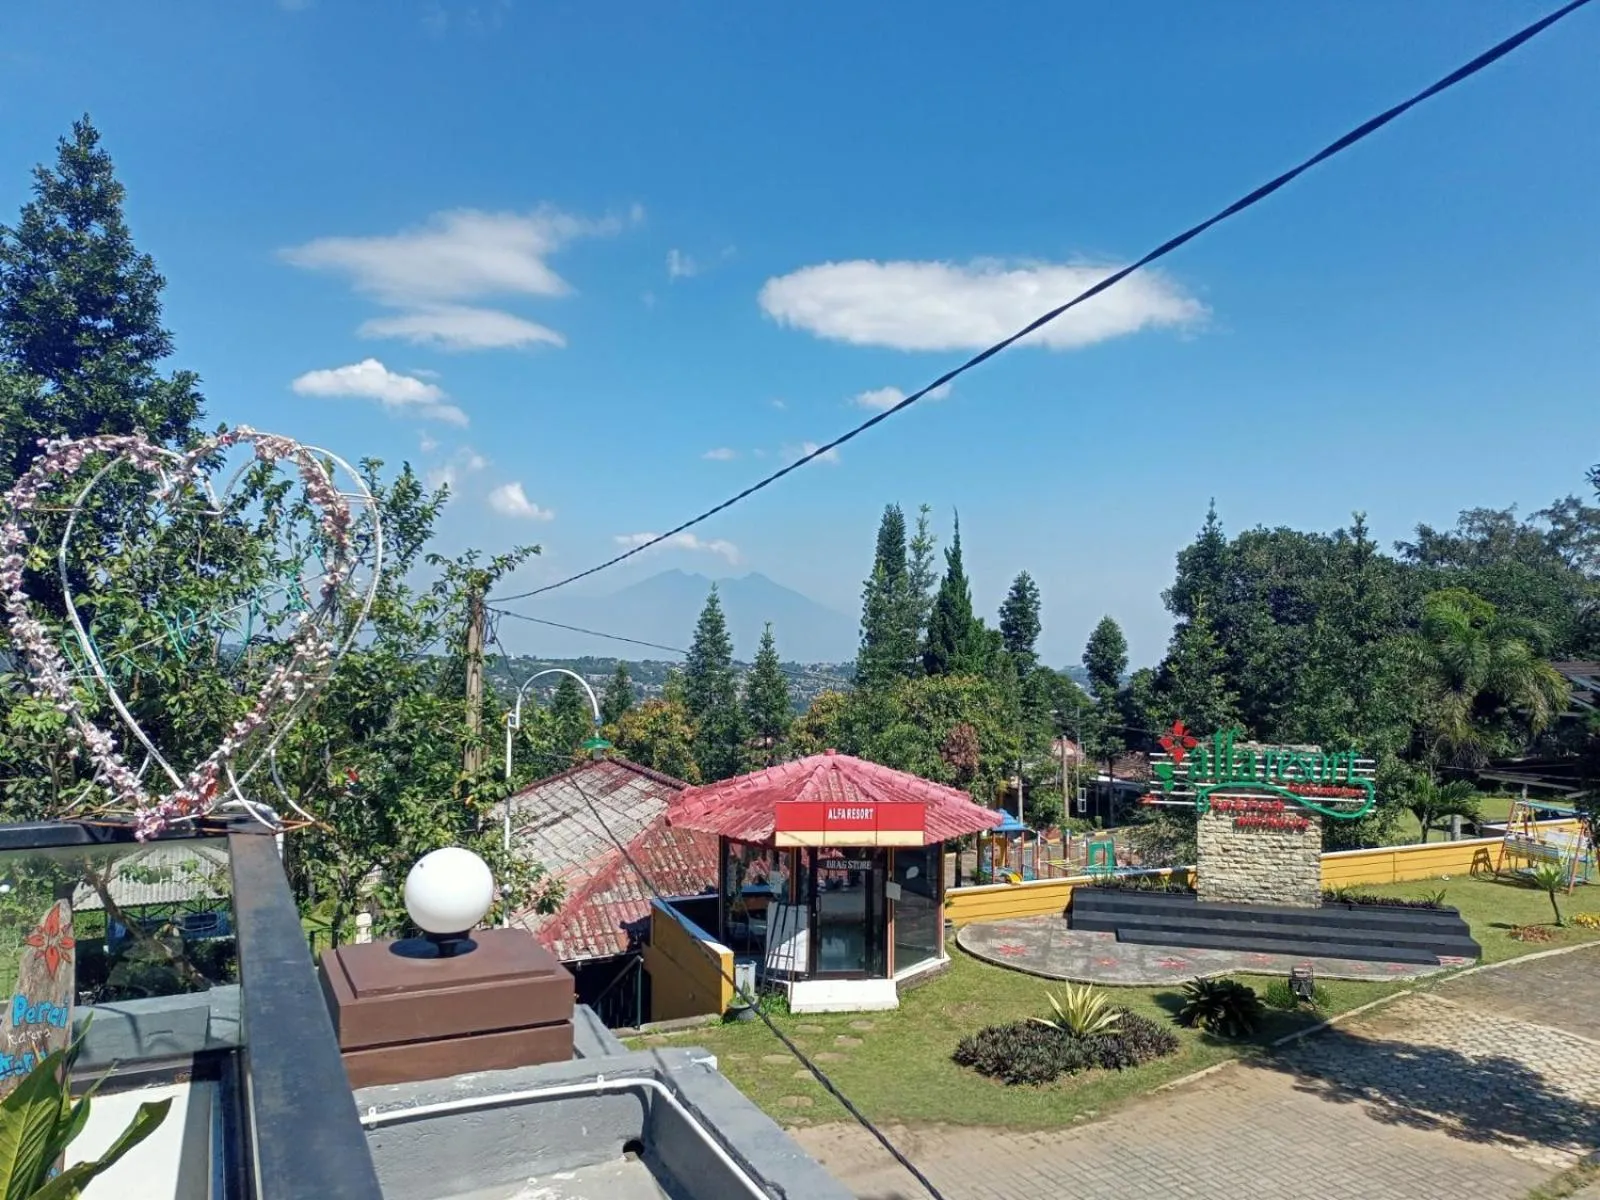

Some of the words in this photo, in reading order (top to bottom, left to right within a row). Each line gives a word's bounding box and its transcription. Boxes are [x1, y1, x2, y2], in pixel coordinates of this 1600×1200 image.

[1189, 728, 1256, 780] alfa
[1263, 748, 1361, 783] resort
[827, 807, 846, 820] ALFA
[847, 808, 874, 820] RESORT
